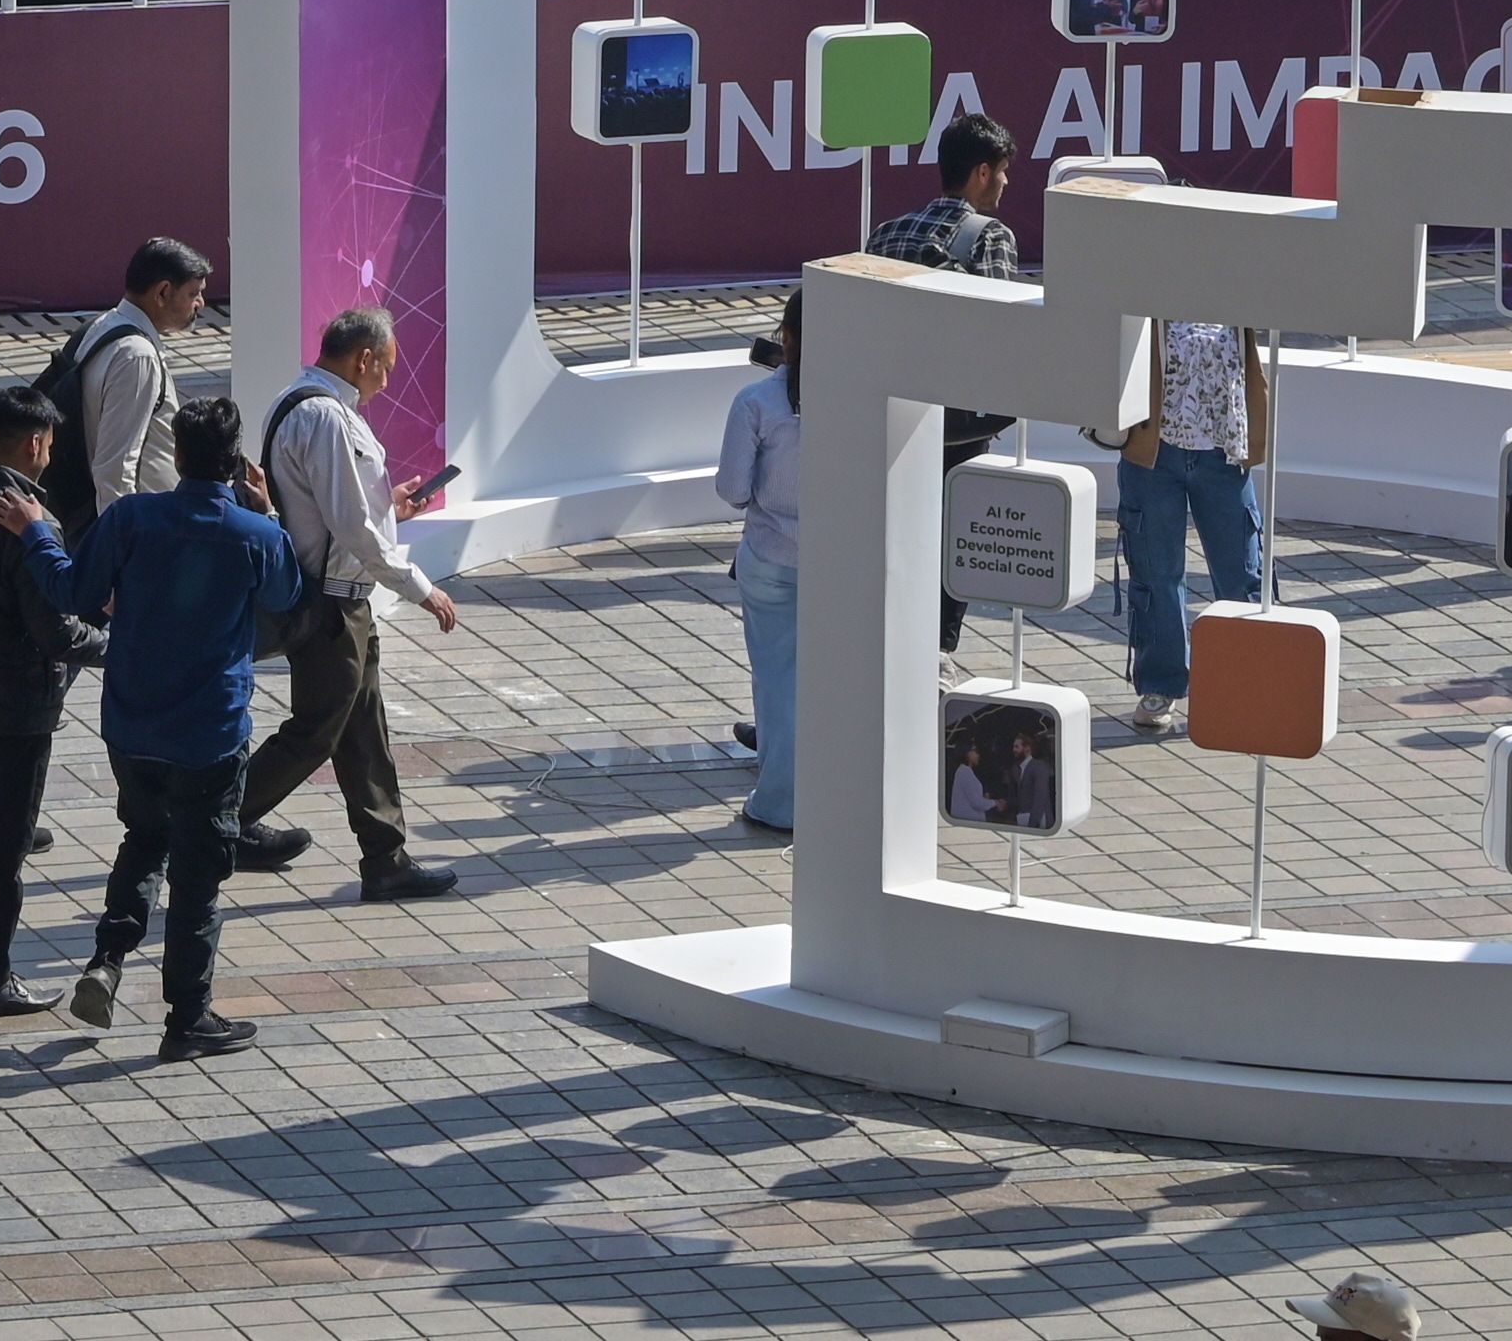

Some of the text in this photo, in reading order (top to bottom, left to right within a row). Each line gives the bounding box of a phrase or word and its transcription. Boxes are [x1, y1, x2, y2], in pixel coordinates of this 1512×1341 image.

[1031, 64, 1143, 160] AI
[986, 506, 1027, 522] AI for
[969, 520, 1043, 543] Economic
[955, 539, 1056, 563] Development
[955, 556, 1055, 580] & Social Good
